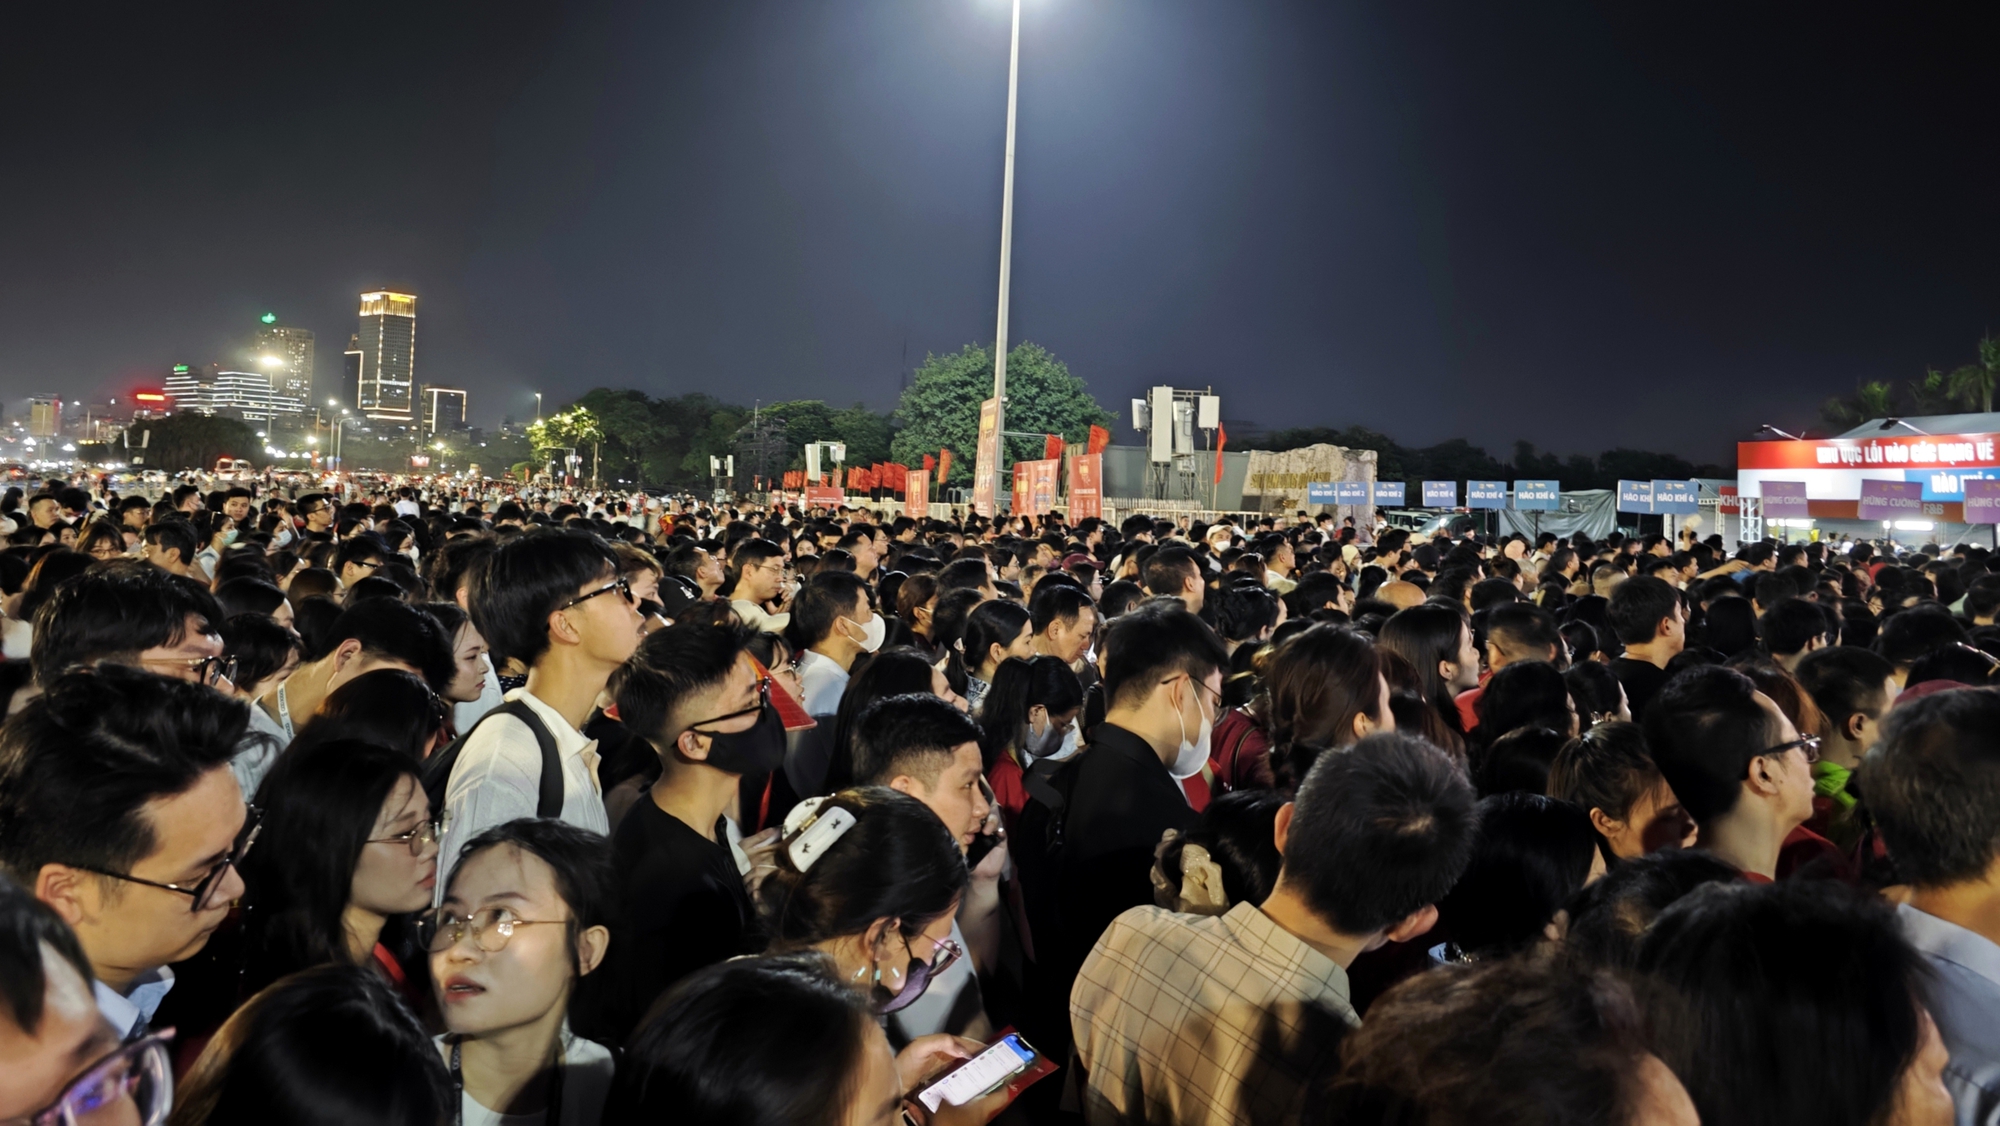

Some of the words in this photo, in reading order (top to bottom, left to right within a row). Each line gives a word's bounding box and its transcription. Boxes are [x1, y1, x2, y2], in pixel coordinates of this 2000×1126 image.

[1864, 440, 1883, 463] LỐI
[1885, 442, 1909, 463] VÀO
[1931, 471, 1958, 493] HÀO
[1471, 491, 1485, 499] HÀO
[1518, 491, 1534, 500] HÀO
[1535, 490, 1549, 500] KHÍ
[1549, 491, 1556, 500] 6
[1622, 492, 1639, 502] HÀO
[1657, 491, 1673, 502] HÀO
[1674, 492, 1688, 503] KHÍ
[1688, 494, 1695, 503] 6
[1862, 495, 1888, 506] HÙNG
[1967, 496, 1993, 508] HÙNG
[1923, 503, 1944, 515] F&B
